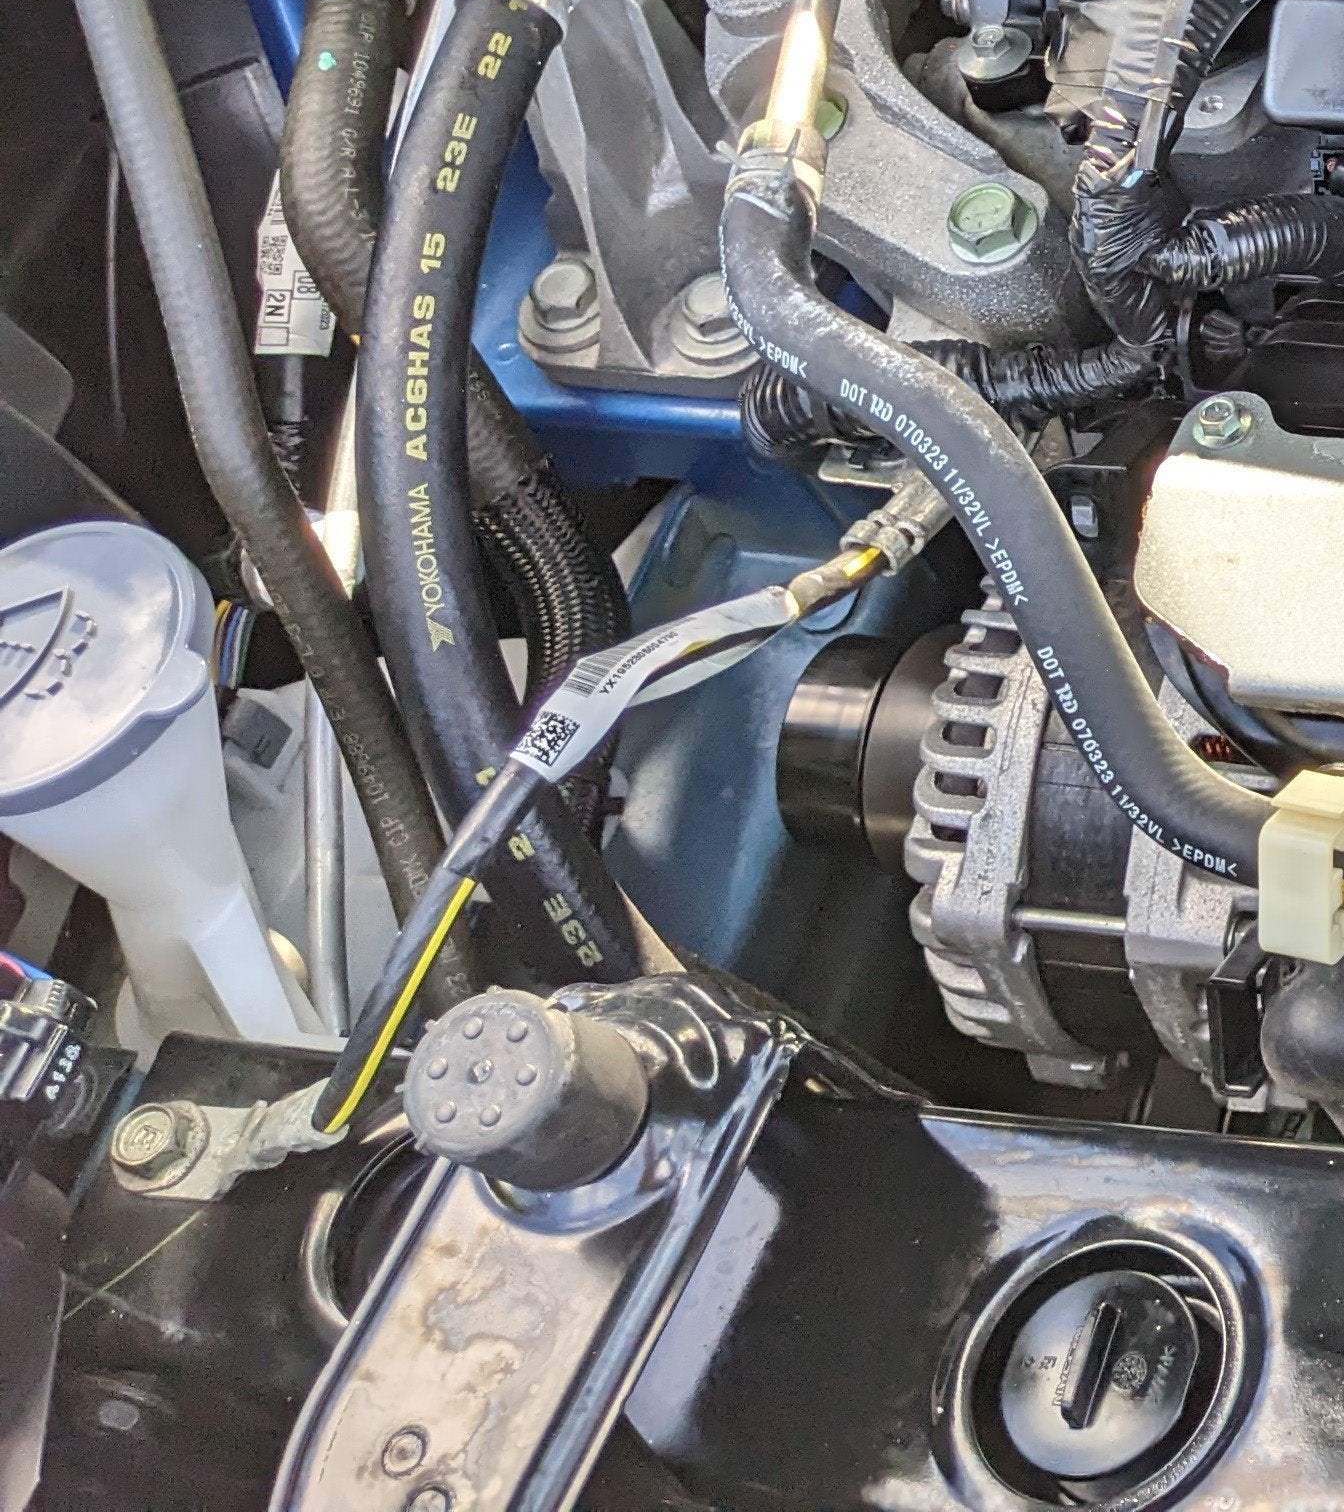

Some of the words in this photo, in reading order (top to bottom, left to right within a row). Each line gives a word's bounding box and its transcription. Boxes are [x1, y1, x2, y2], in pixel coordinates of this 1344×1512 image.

[477, 30, 515, 82] 22
[436, 111, 480, 194] 23E
[420, 232, 448, 276] 15
[266, 292, 286, 318] 2N
[403, 293, 437, 462] AC6HAS
[758, 333, 809, 381] >EPDM<
[839, 377, 870, 409] DOT
[894, 413, 950, 473] 070323
[942, 467, 994, 539] 11/32VL
[983, 536, 1032, 608] >EPDM<
[410, 481, 448, 614] YOKOHAMA
[1036, 645, 1066, 681] DOT
[1071, 717, 1116, 785] 070323
[1110, 783, 1167, 846] 11/32VL
[1170, 836, 1240, 879] >EPDM<
